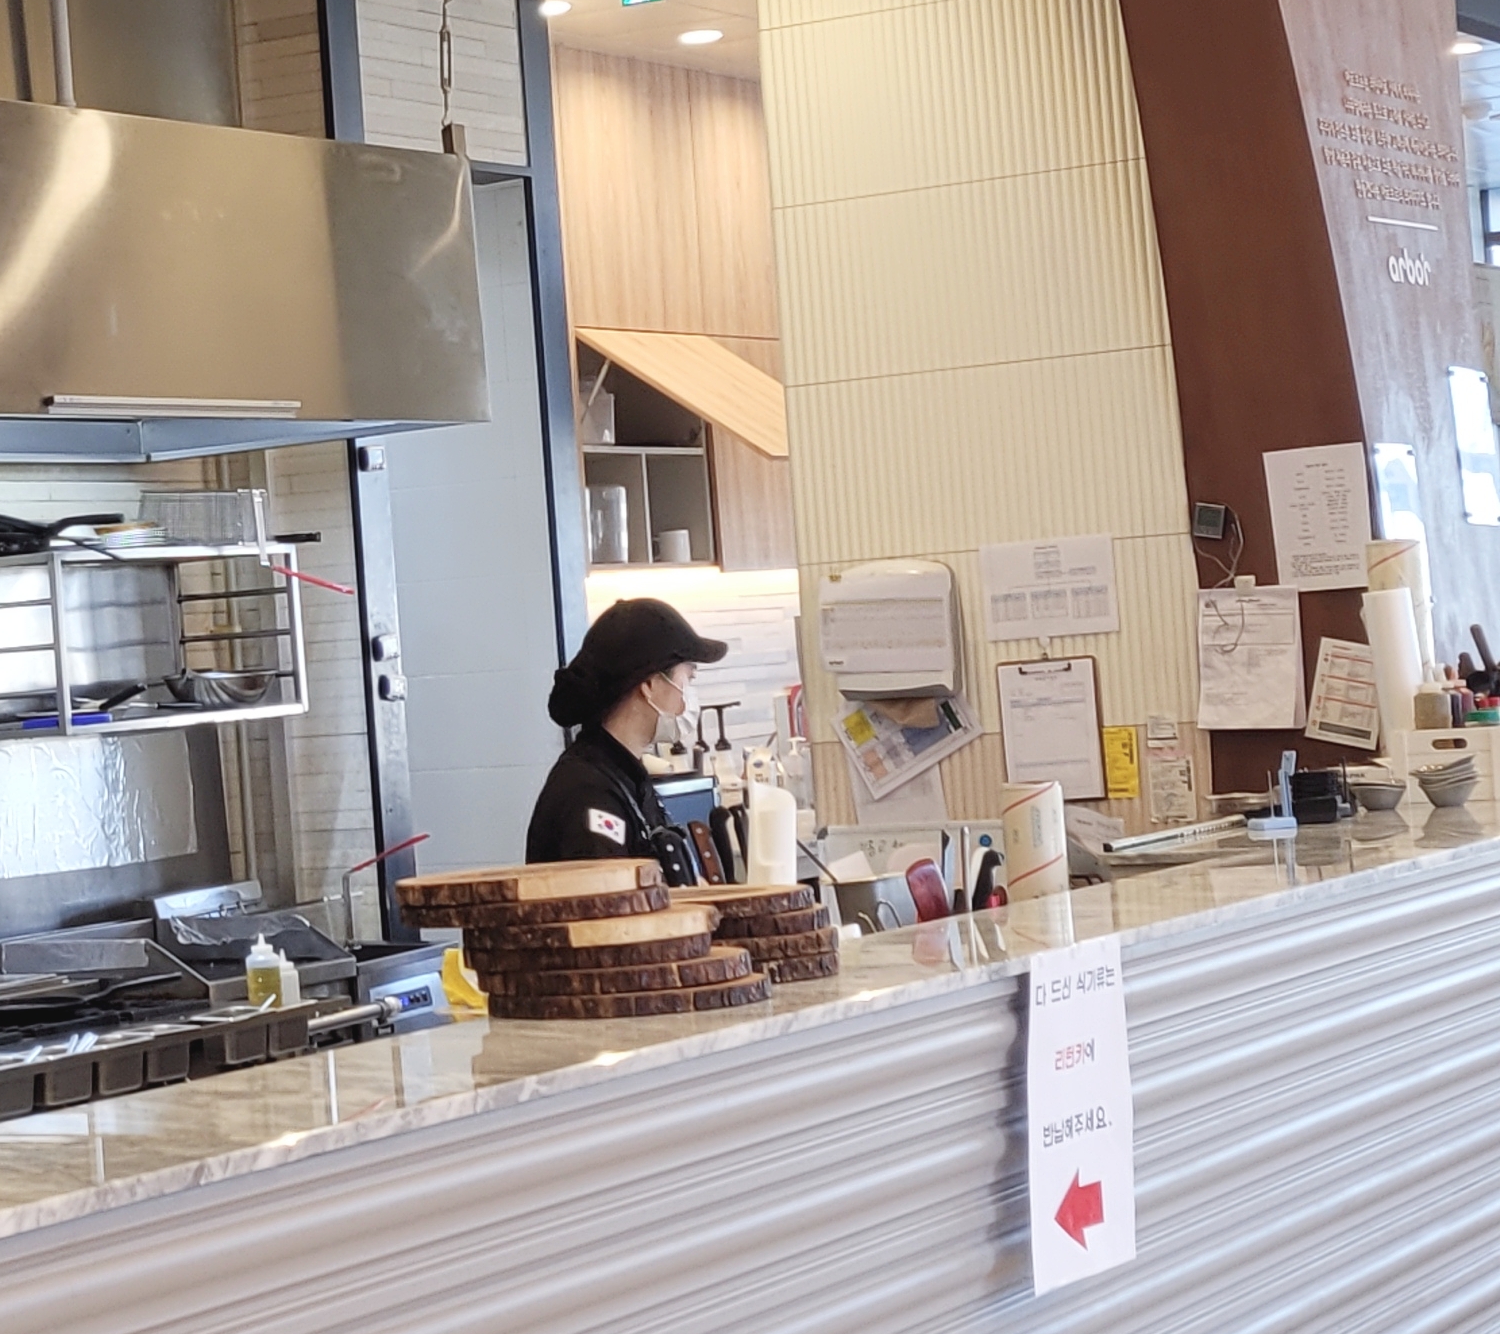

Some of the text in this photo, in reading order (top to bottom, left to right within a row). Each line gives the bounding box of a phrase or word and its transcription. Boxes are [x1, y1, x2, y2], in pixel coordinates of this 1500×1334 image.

[1035, 964, 1115, 1007] 다 드신 식기류는
[1043, 1105, 1113, 1148] 반납해주세요.
